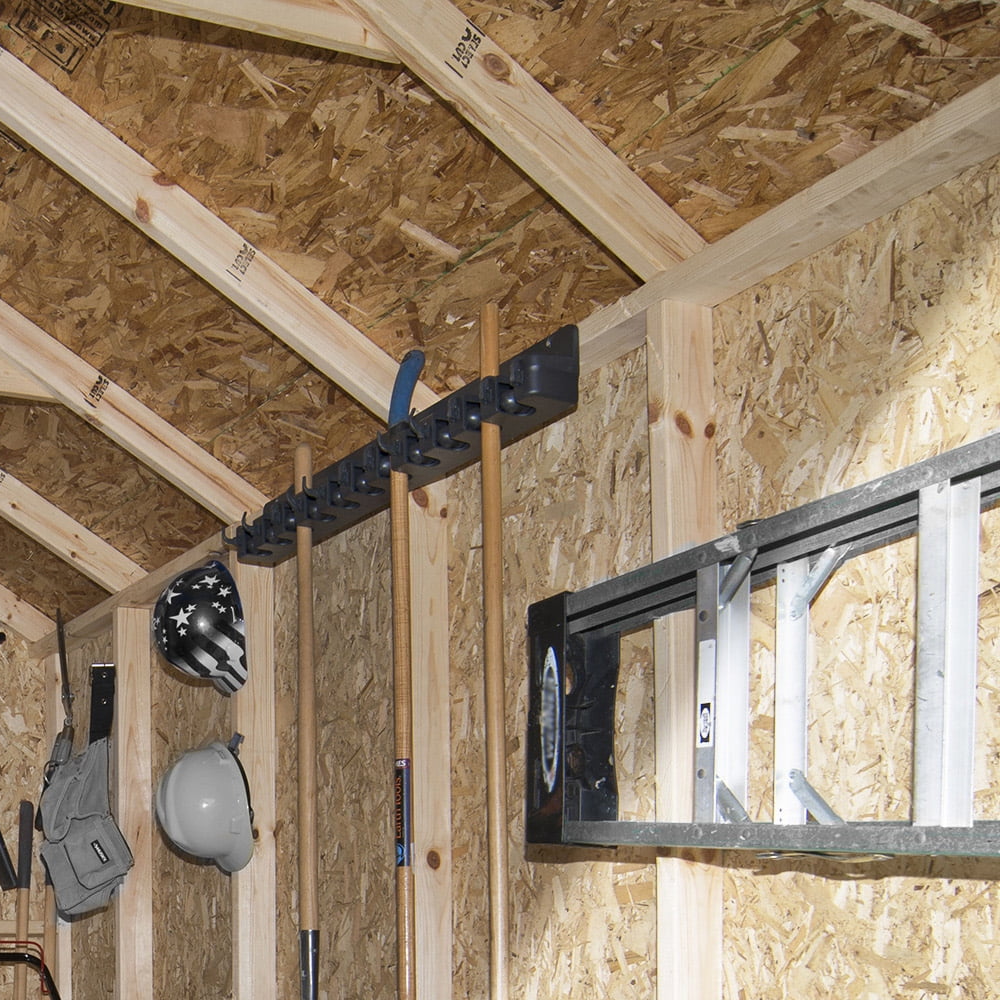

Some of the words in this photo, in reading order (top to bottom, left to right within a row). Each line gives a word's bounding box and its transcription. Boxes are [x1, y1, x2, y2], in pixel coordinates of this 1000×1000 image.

[451, 42, 467, 62] CUT
[460, 33, 482, 69] SELECT
[232, 254, 244, 270] CUT
[88, 384, 99, 398] CUT
